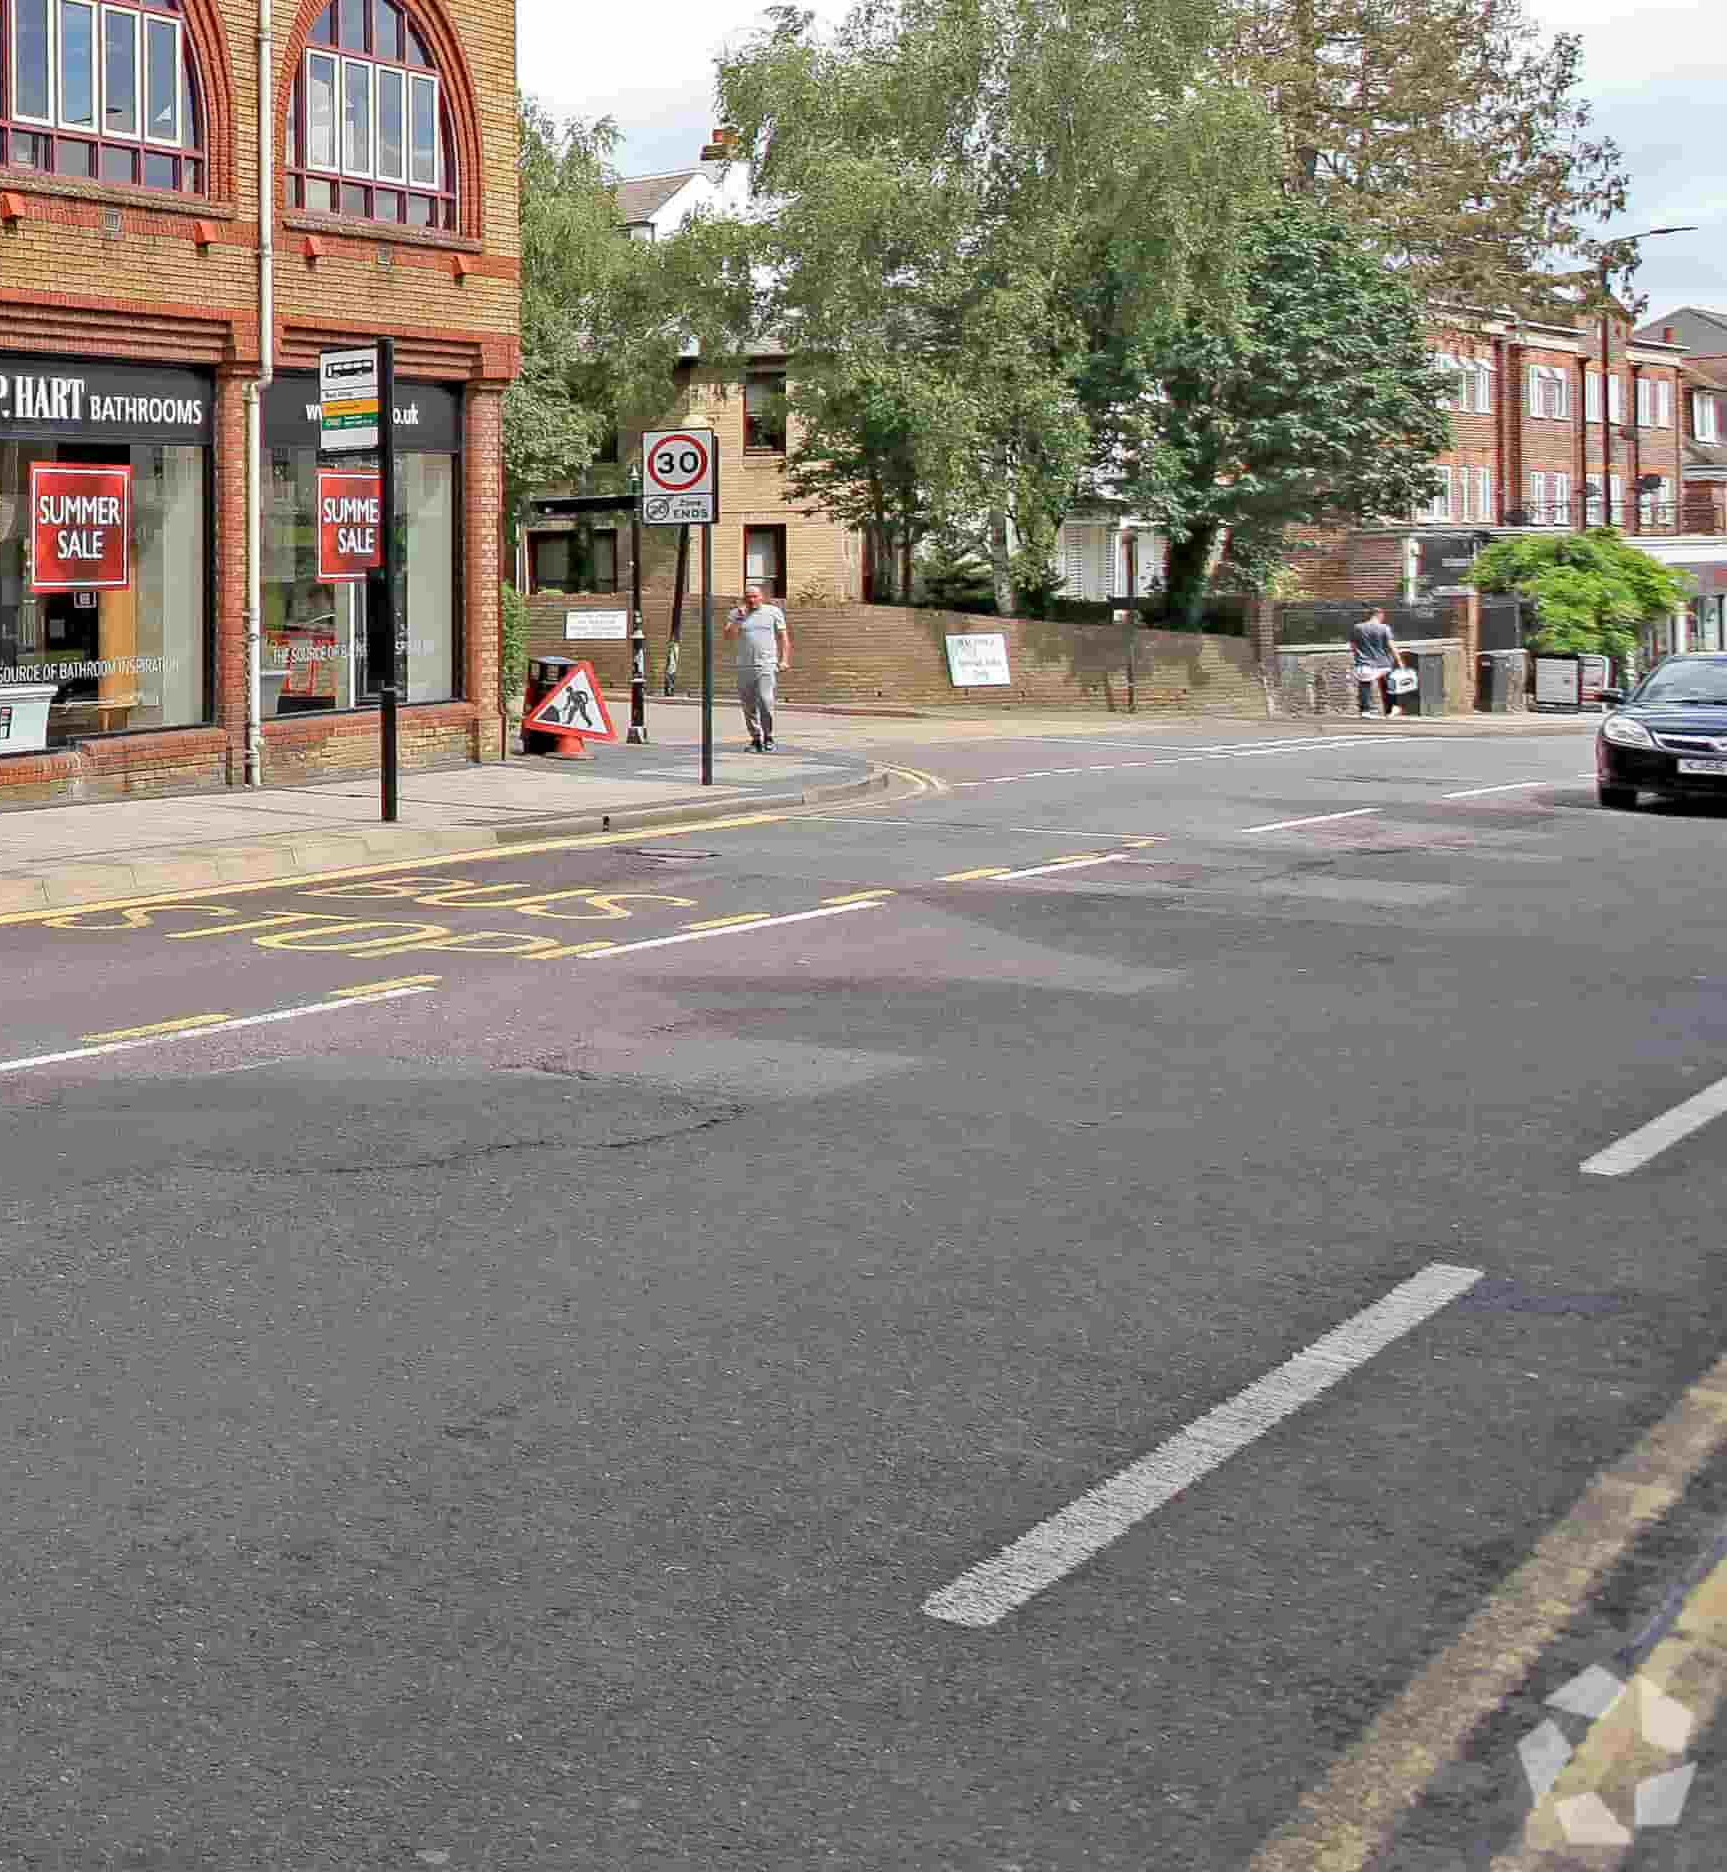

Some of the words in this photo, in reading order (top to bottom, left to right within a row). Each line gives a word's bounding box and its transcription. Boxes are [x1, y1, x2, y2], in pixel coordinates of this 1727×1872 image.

[15, 375, 85, 420] HART
[89, 395, 203, 425] BATHROOMS
[657, 451, 699, 474] 30
[39, 495, 122, 526] SUMMER
[57, 530, 104, 559] SALE
[338, 527, 375, 553] SALE
[42, 663, 58, 681] OF
[296, 876, 698, 920] BUS
[41, 903, 563, 959] STOP
